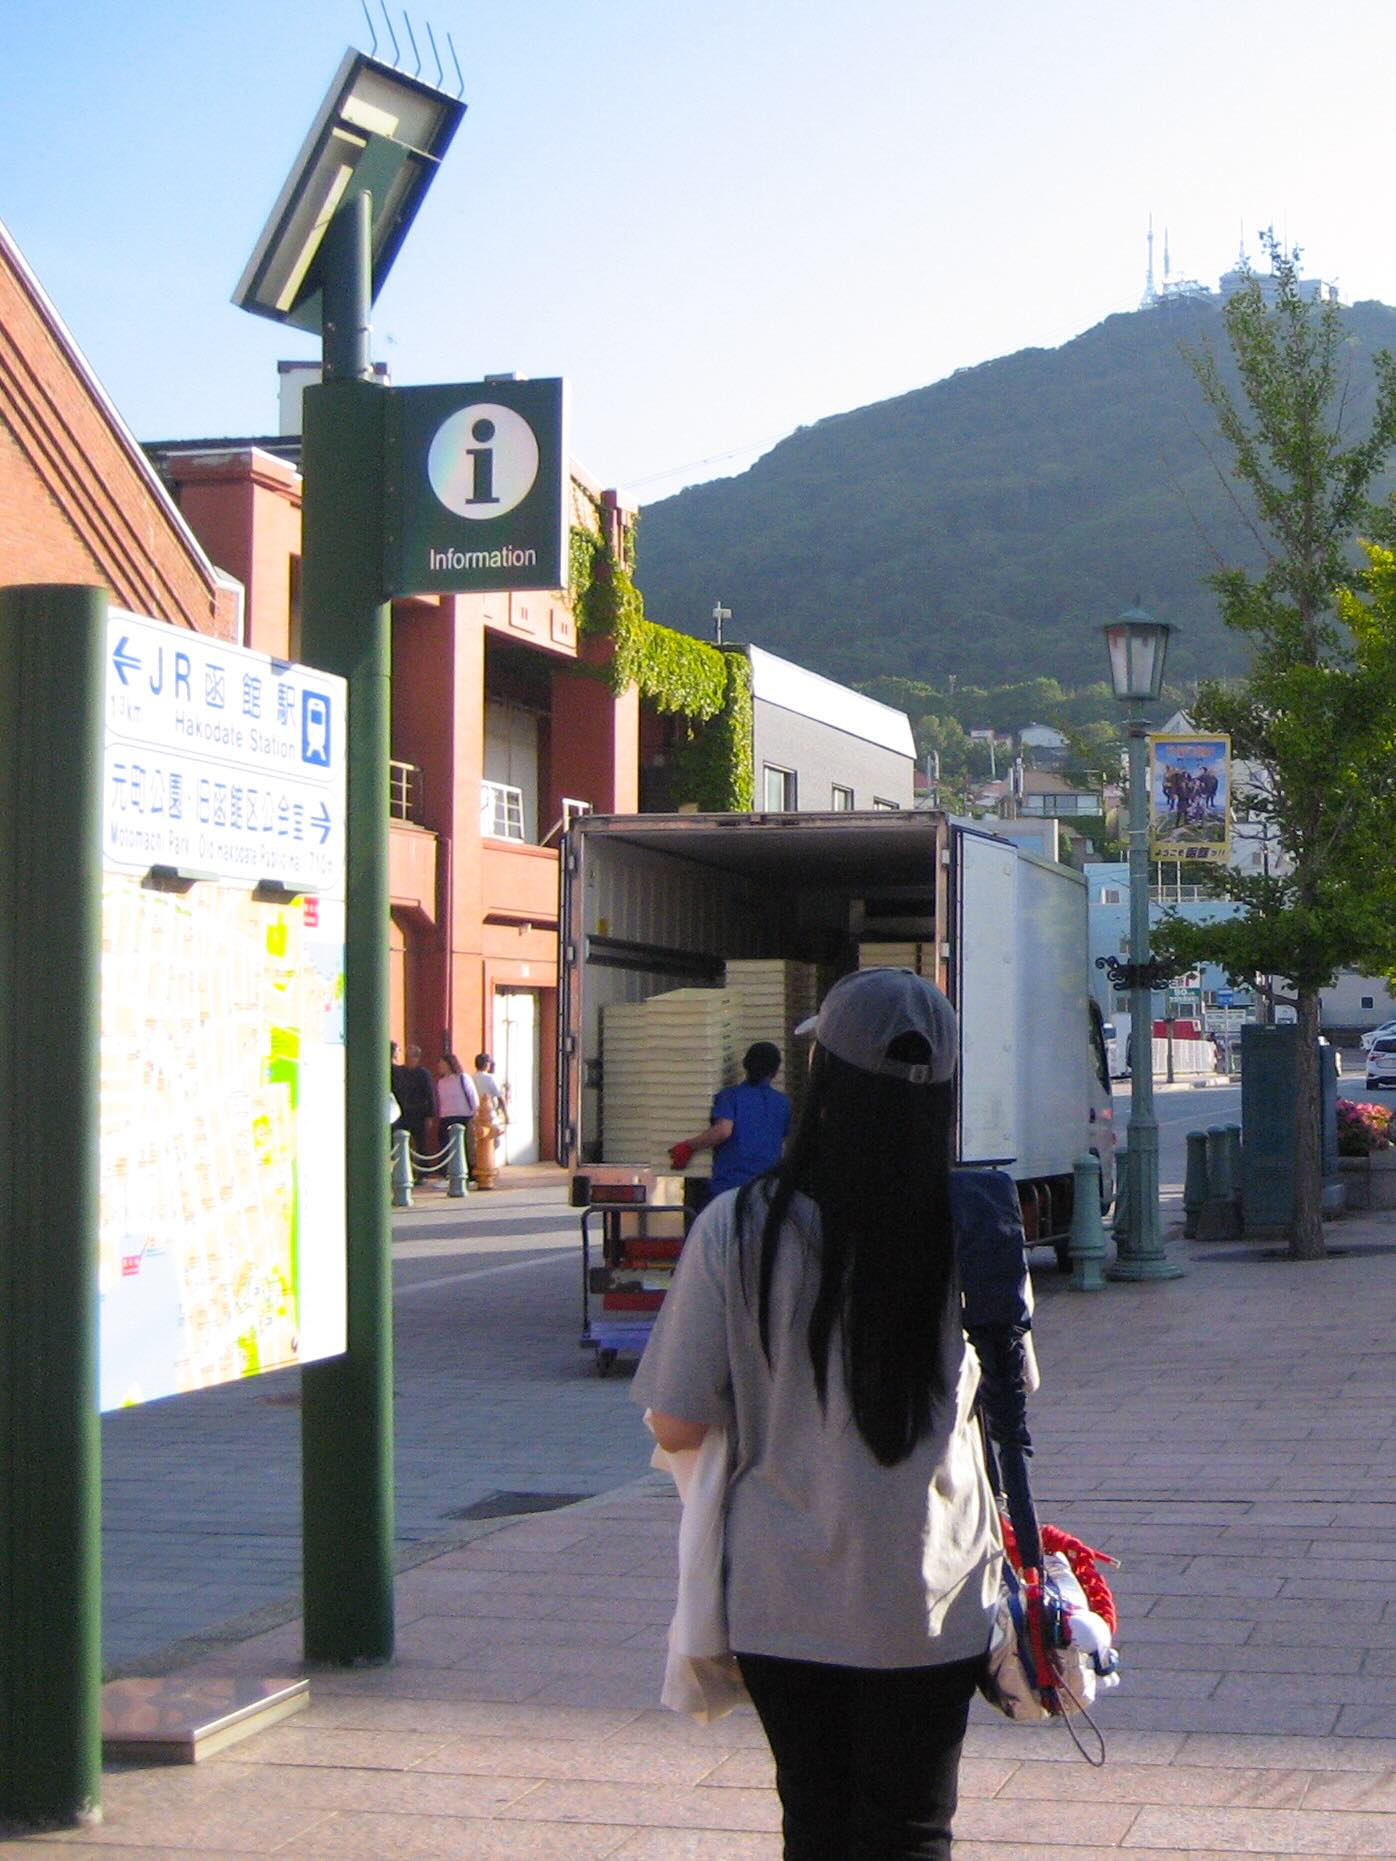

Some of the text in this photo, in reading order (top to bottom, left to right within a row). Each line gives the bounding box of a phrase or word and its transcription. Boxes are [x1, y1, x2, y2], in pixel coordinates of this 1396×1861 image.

[430, 545, 536, 571] Information
[174, 709, 296, 760] Hakodate Station
